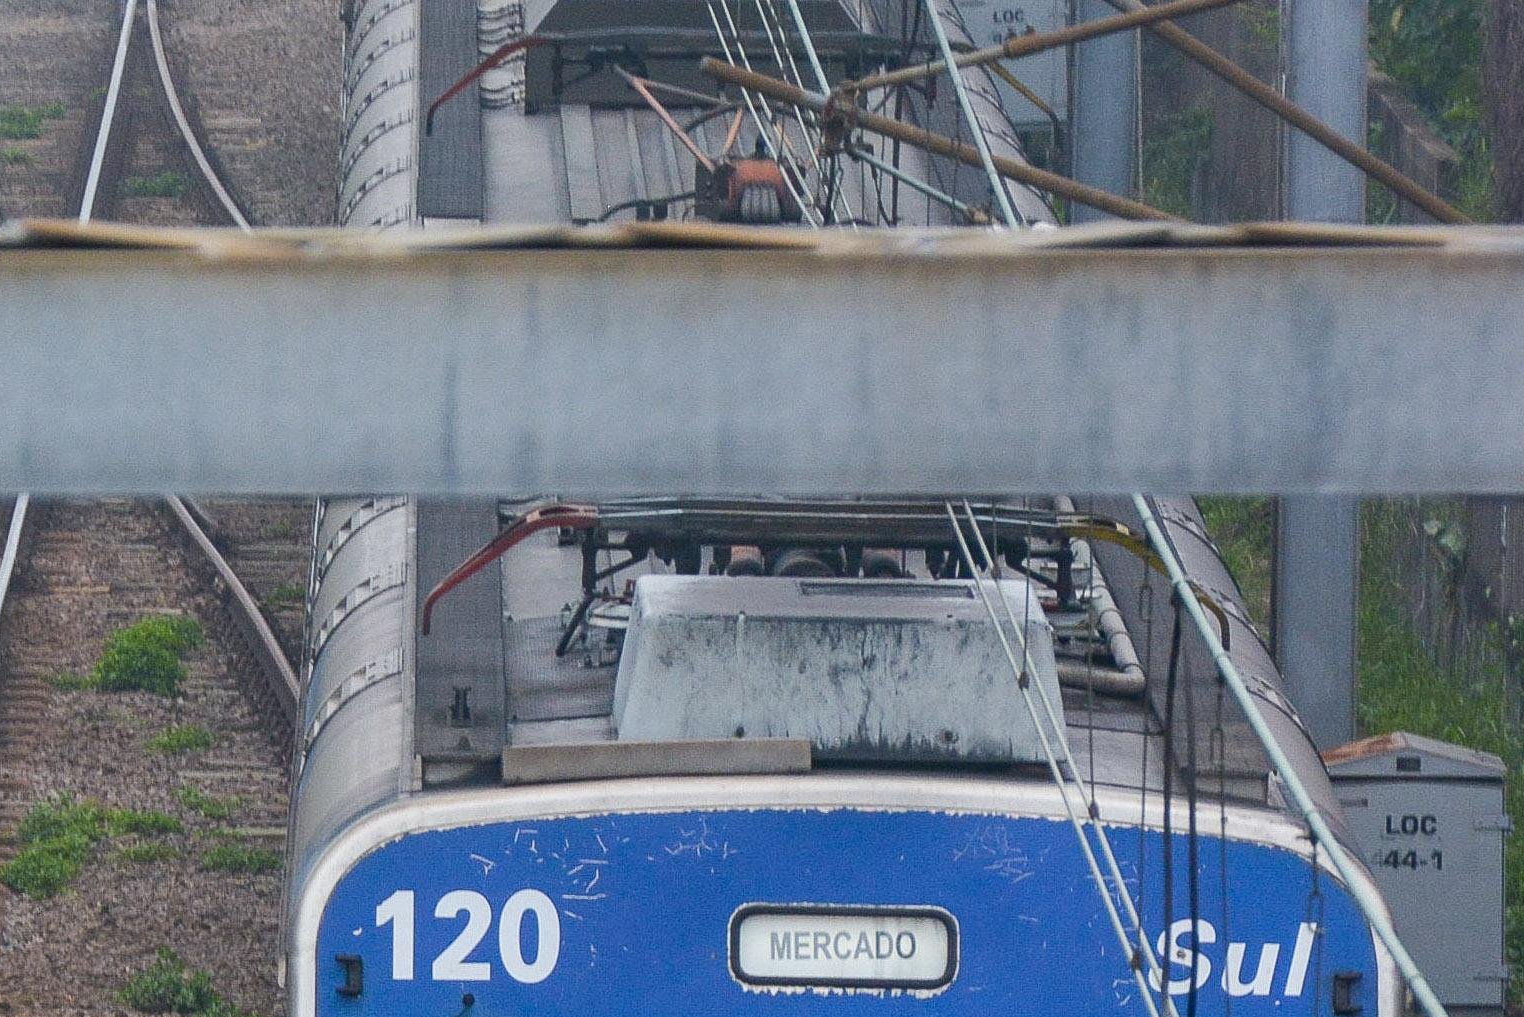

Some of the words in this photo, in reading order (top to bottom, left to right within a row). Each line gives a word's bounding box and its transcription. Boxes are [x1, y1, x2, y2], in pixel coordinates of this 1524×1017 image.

[992, 8, 1024, 23] LOC
[1385, 814, 1438, 834] LOC
[1383, 848, 1443, 871] 44-1
[375, 888, 562, 984] 120
[770, 930, 917, 960] MERCADO
[1148, 917, 1318, 998] Sul
